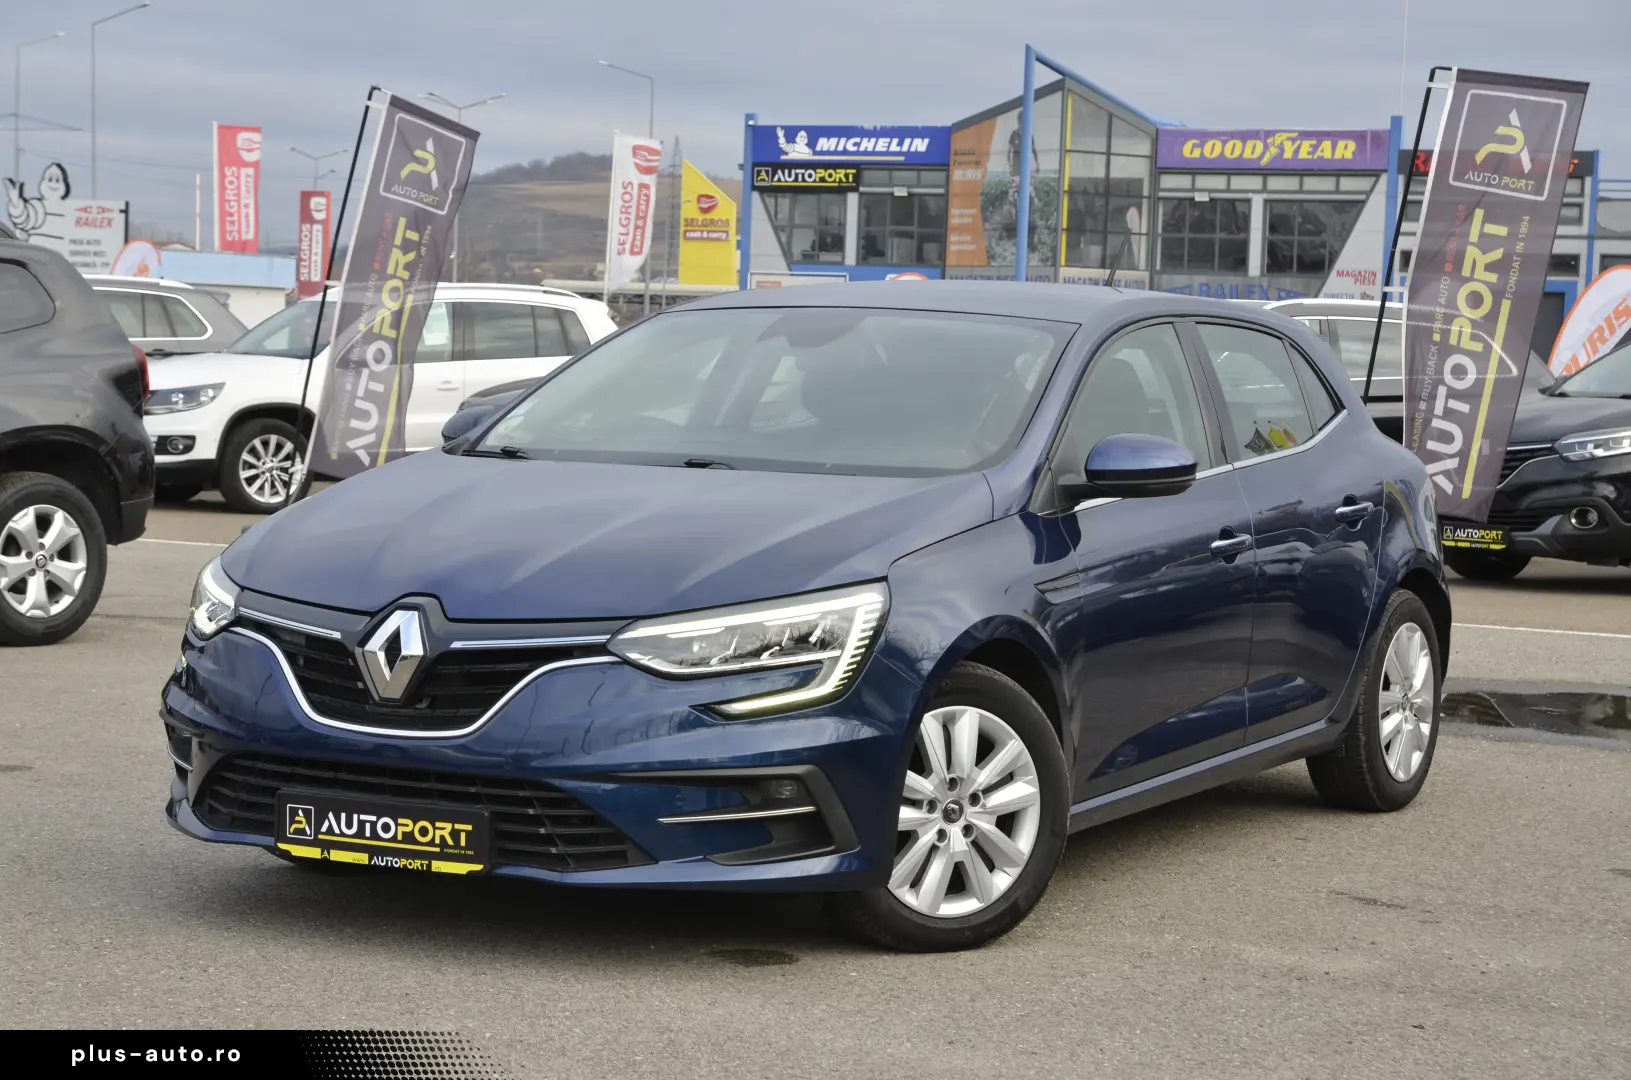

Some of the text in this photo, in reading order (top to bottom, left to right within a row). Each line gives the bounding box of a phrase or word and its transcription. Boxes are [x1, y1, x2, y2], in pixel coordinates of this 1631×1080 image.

[815, 137, 930, 152] MICHELIN
[773, 168, 856, 183] AUTOPORT
[1464, 170, 1535, 192] AUTO PORT
[391, 184, 418, 198] AUTO
[225, 166, 239, 241] SELGROS
[75, 216, 114, 228] RAILEX
[617, 180, 634, 257] SELGROS
[684, 217, 730, 228] SELGROS
[708, 231, 727, 239] carry
[300, 223, 311, 281] SELGROS
[1506, 215, 1531, 298] FONDAT IN 1994
[366, 273, 378, 298] AUTO
[1336, 269, 1377, 279] MAGAZIN
[1353, 278, 1377, 286] PIESE
[1438, 276, 1451, 305] AUTO
[1433, 307, 1444, 332] PARC
[345, 216, 420, 467] AUTOPORT
[1425, 207, 1508, 496] AUTOPORT
[1426, 344, 1439, 375] BACK
[1422, 376, 1433, 400] BUY
[1454, 528, 1503, 539] AUTOPORT
[320, 811, 473, 847] AUTOPORT
[370, 855, 429, 871] AUTOPORT
